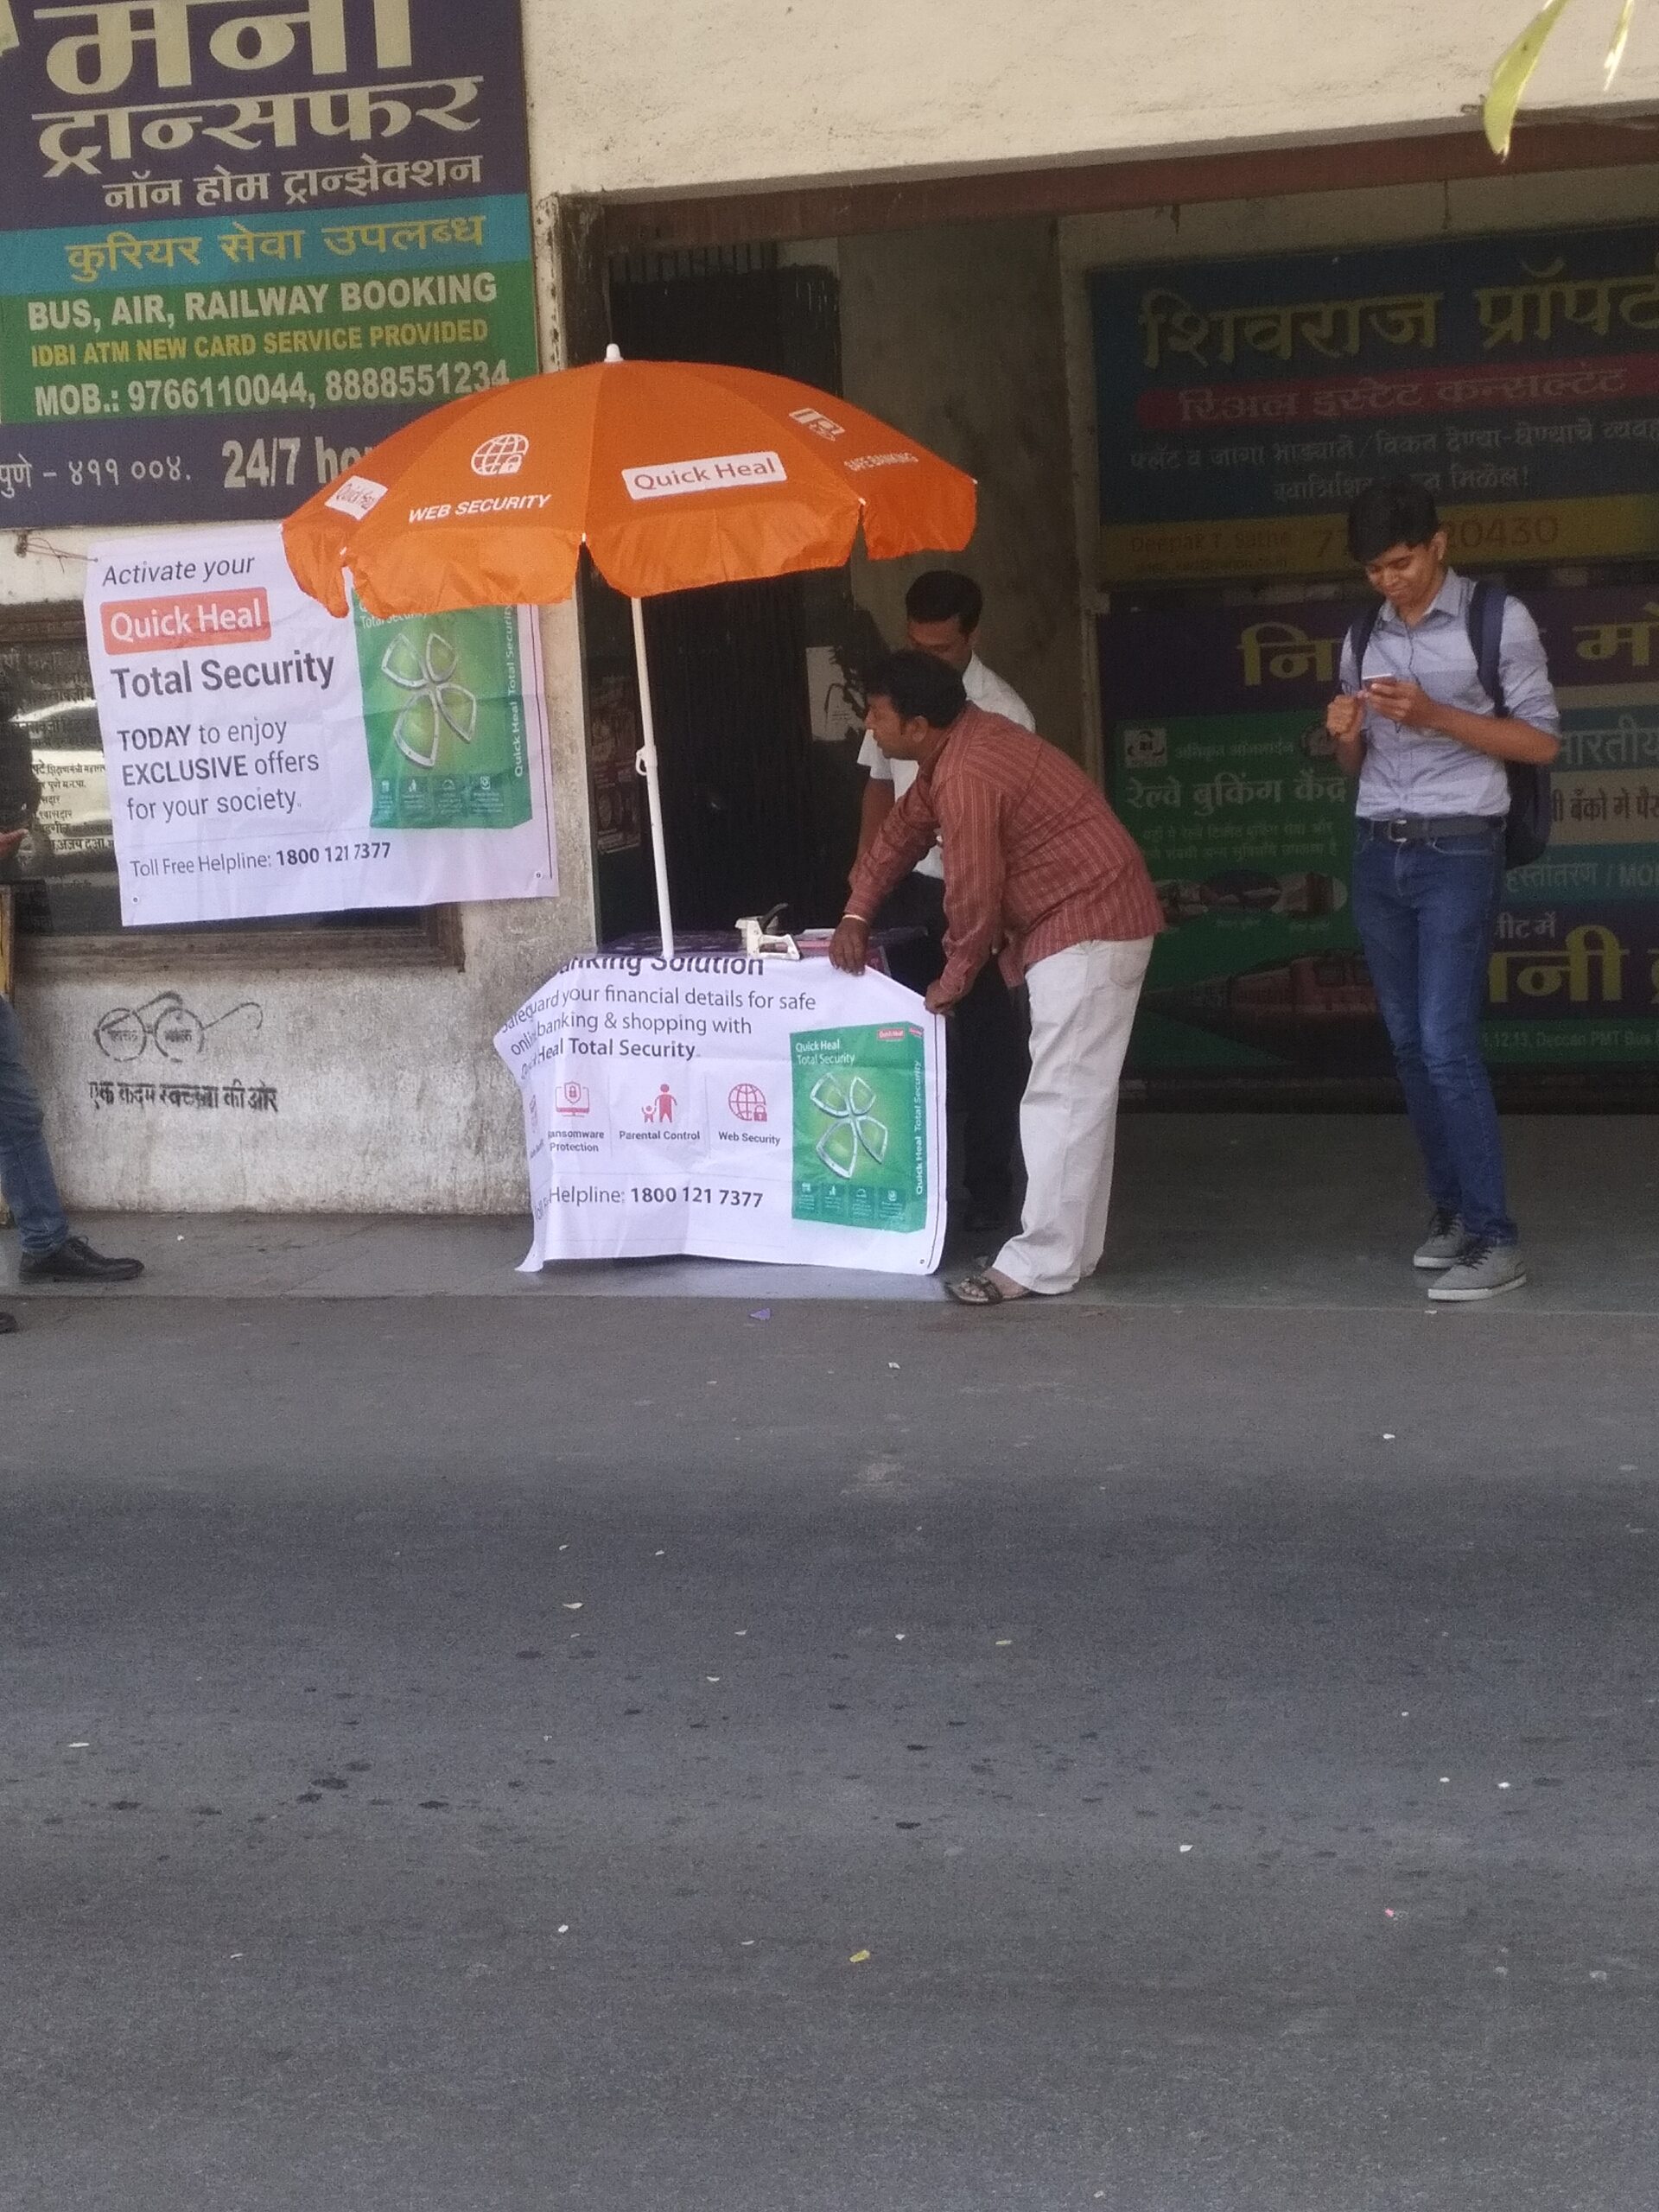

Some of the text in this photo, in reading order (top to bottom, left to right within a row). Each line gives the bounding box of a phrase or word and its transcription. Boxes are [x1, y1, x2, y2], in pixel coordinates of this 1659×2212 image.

[31, 76, 484, 178] ट्रान्सफर
[102, 170, 181, 211] नॉन
[194, 164, 270, 207] होम
[65, 215, 486, 283] कुरियर सेवा उपलब्ध
[28, 272, 497, 334] BUS, AIR, RAILWAY BOOKING
[31, 319, 489, 367] IDBI ATM NEW CARD SERVICE PROVIDED
[1138, 288, 1445, 369] शिवराज
[35, 359, 510, 417] MOB.: 9766110044, 8888551234
[221, 436, 375, 489] 24/7 ho
[634, 457, 776, 491] Quick Heal
[409, 494, 552, 524] WEB SECURITY
[102, 556, 256, 587] Activate your
[110, 598, 263, 643] Quick Heal
[111, 659, 193, 699] Total
[201, 650, 334, 690] Security
[117, 724, 191, 752] TODAY
[199, 724, 220, 745] to
[228, 716, 287, 746] enjoy
[122, 750, 319, 786] EXCLUSIVE offers
[127, 798, 156, 820] for
[163, 797, 209, 823] your
[1192, 772, 1284, 817] बुकिंग
[130, 842, 391, 877] Toll Free Helpline: 1800 121 7377
[562, 986, 600, 1007] your
[605, 984, 679, 1005] financial
[685, 986, 743, 1007] details
[747, 990, 773, 1009] for
[779, 992, 817, 1010] safe
[537, 1011, 598, 1037] banking
[605, 1014, 618, 1030] &
[623, 1011, 707, 1035] shopping
[713, 1017, 753, 1035] with
[569, 1037, 613, 1056] Total
[795, 1038, 840, 1053] Quick Heal
[797, 1052, 855, 1065] Total Security
[912, 1060, 923, 1106] Security
[619, 1130, 700, 1141] Parental Control
[913, 1108, 922, 1134] Total
[550, 1142, 600, 1153] Protection
[718, 1131, 780, 1147] Web Security
[915, 1163, 924, 1195] Quick
[549, 1185, 764, 1208] Helpline: 1800 121 7377
